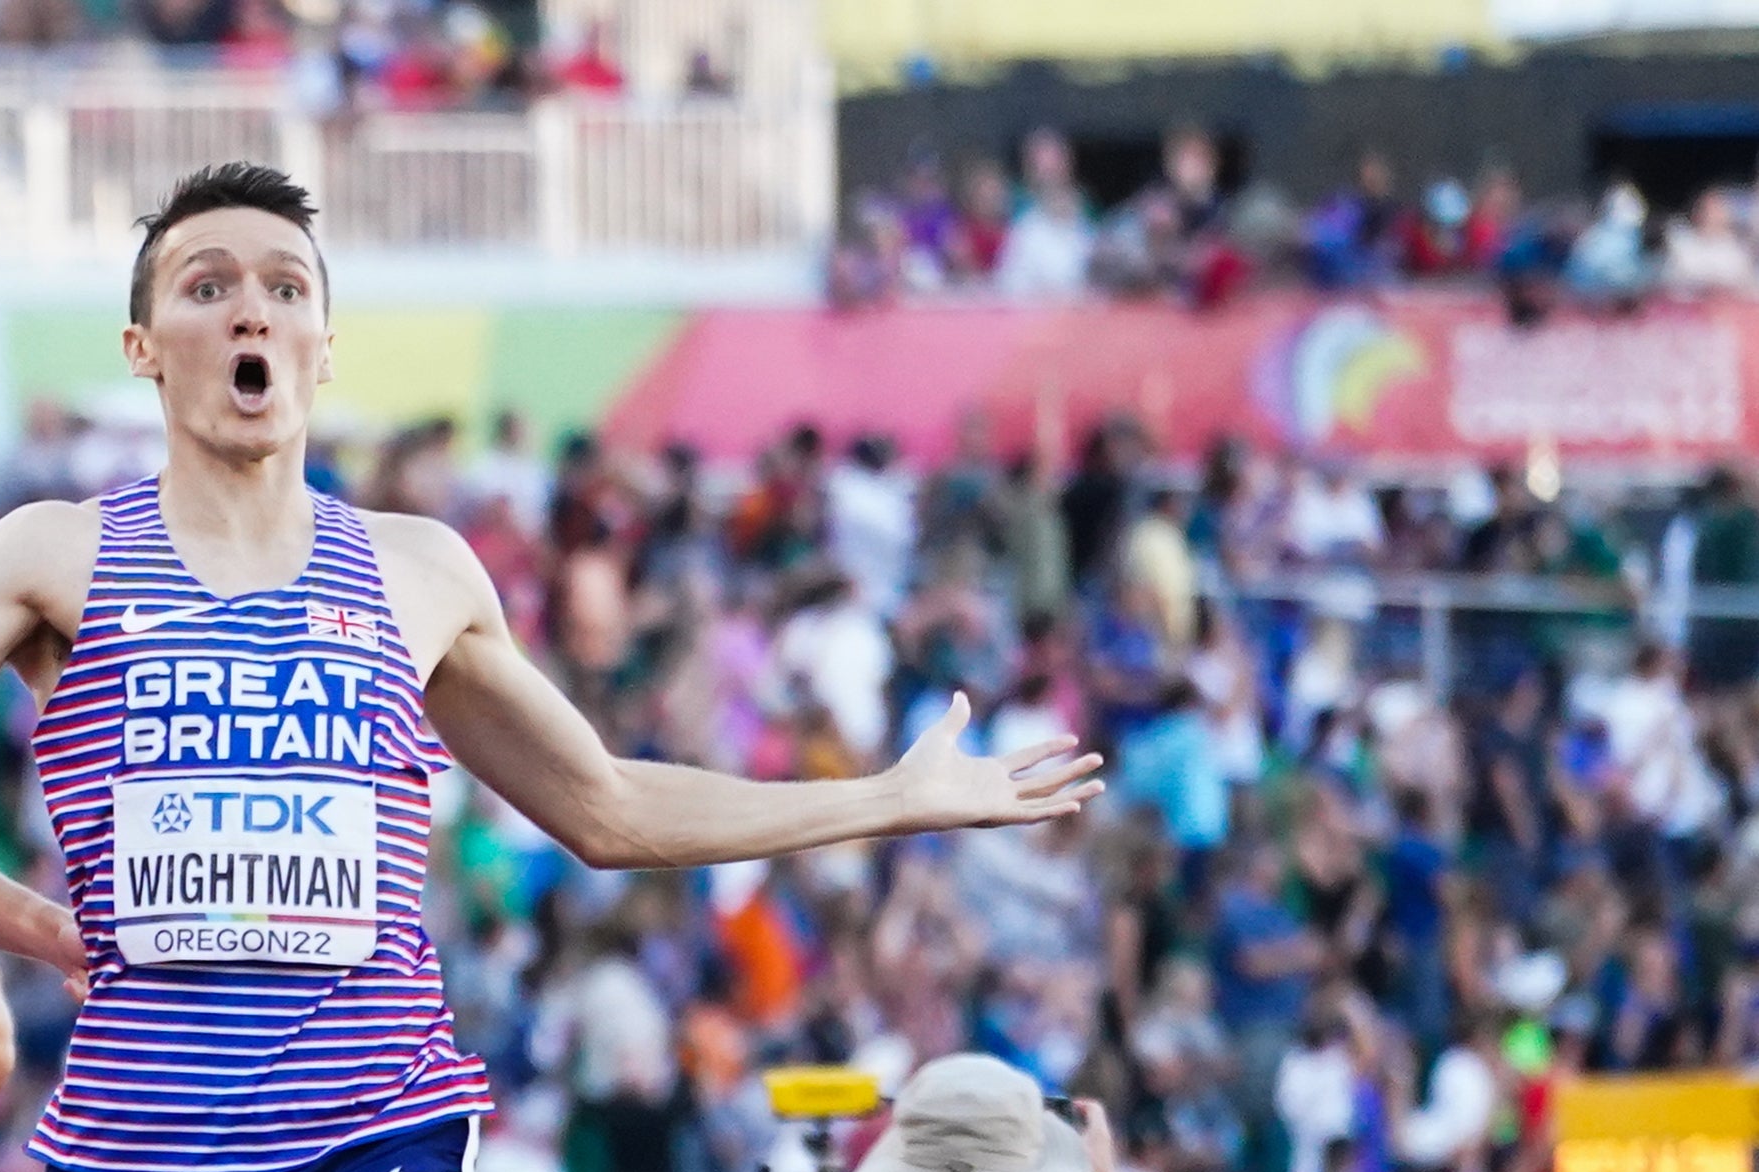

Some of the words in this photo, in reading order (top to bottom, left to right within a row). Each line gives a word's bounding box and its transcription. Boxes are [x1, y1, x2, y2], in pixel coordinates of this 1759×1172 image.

[124, 659, 373, 710] GREAT
[123, 713, 372, 766] BRITAIN
[193, 792, 337, 836] TDK
[128, 853, 361, 909] WIGHTMAN
[153, 928, 332, 955] OREGON22
